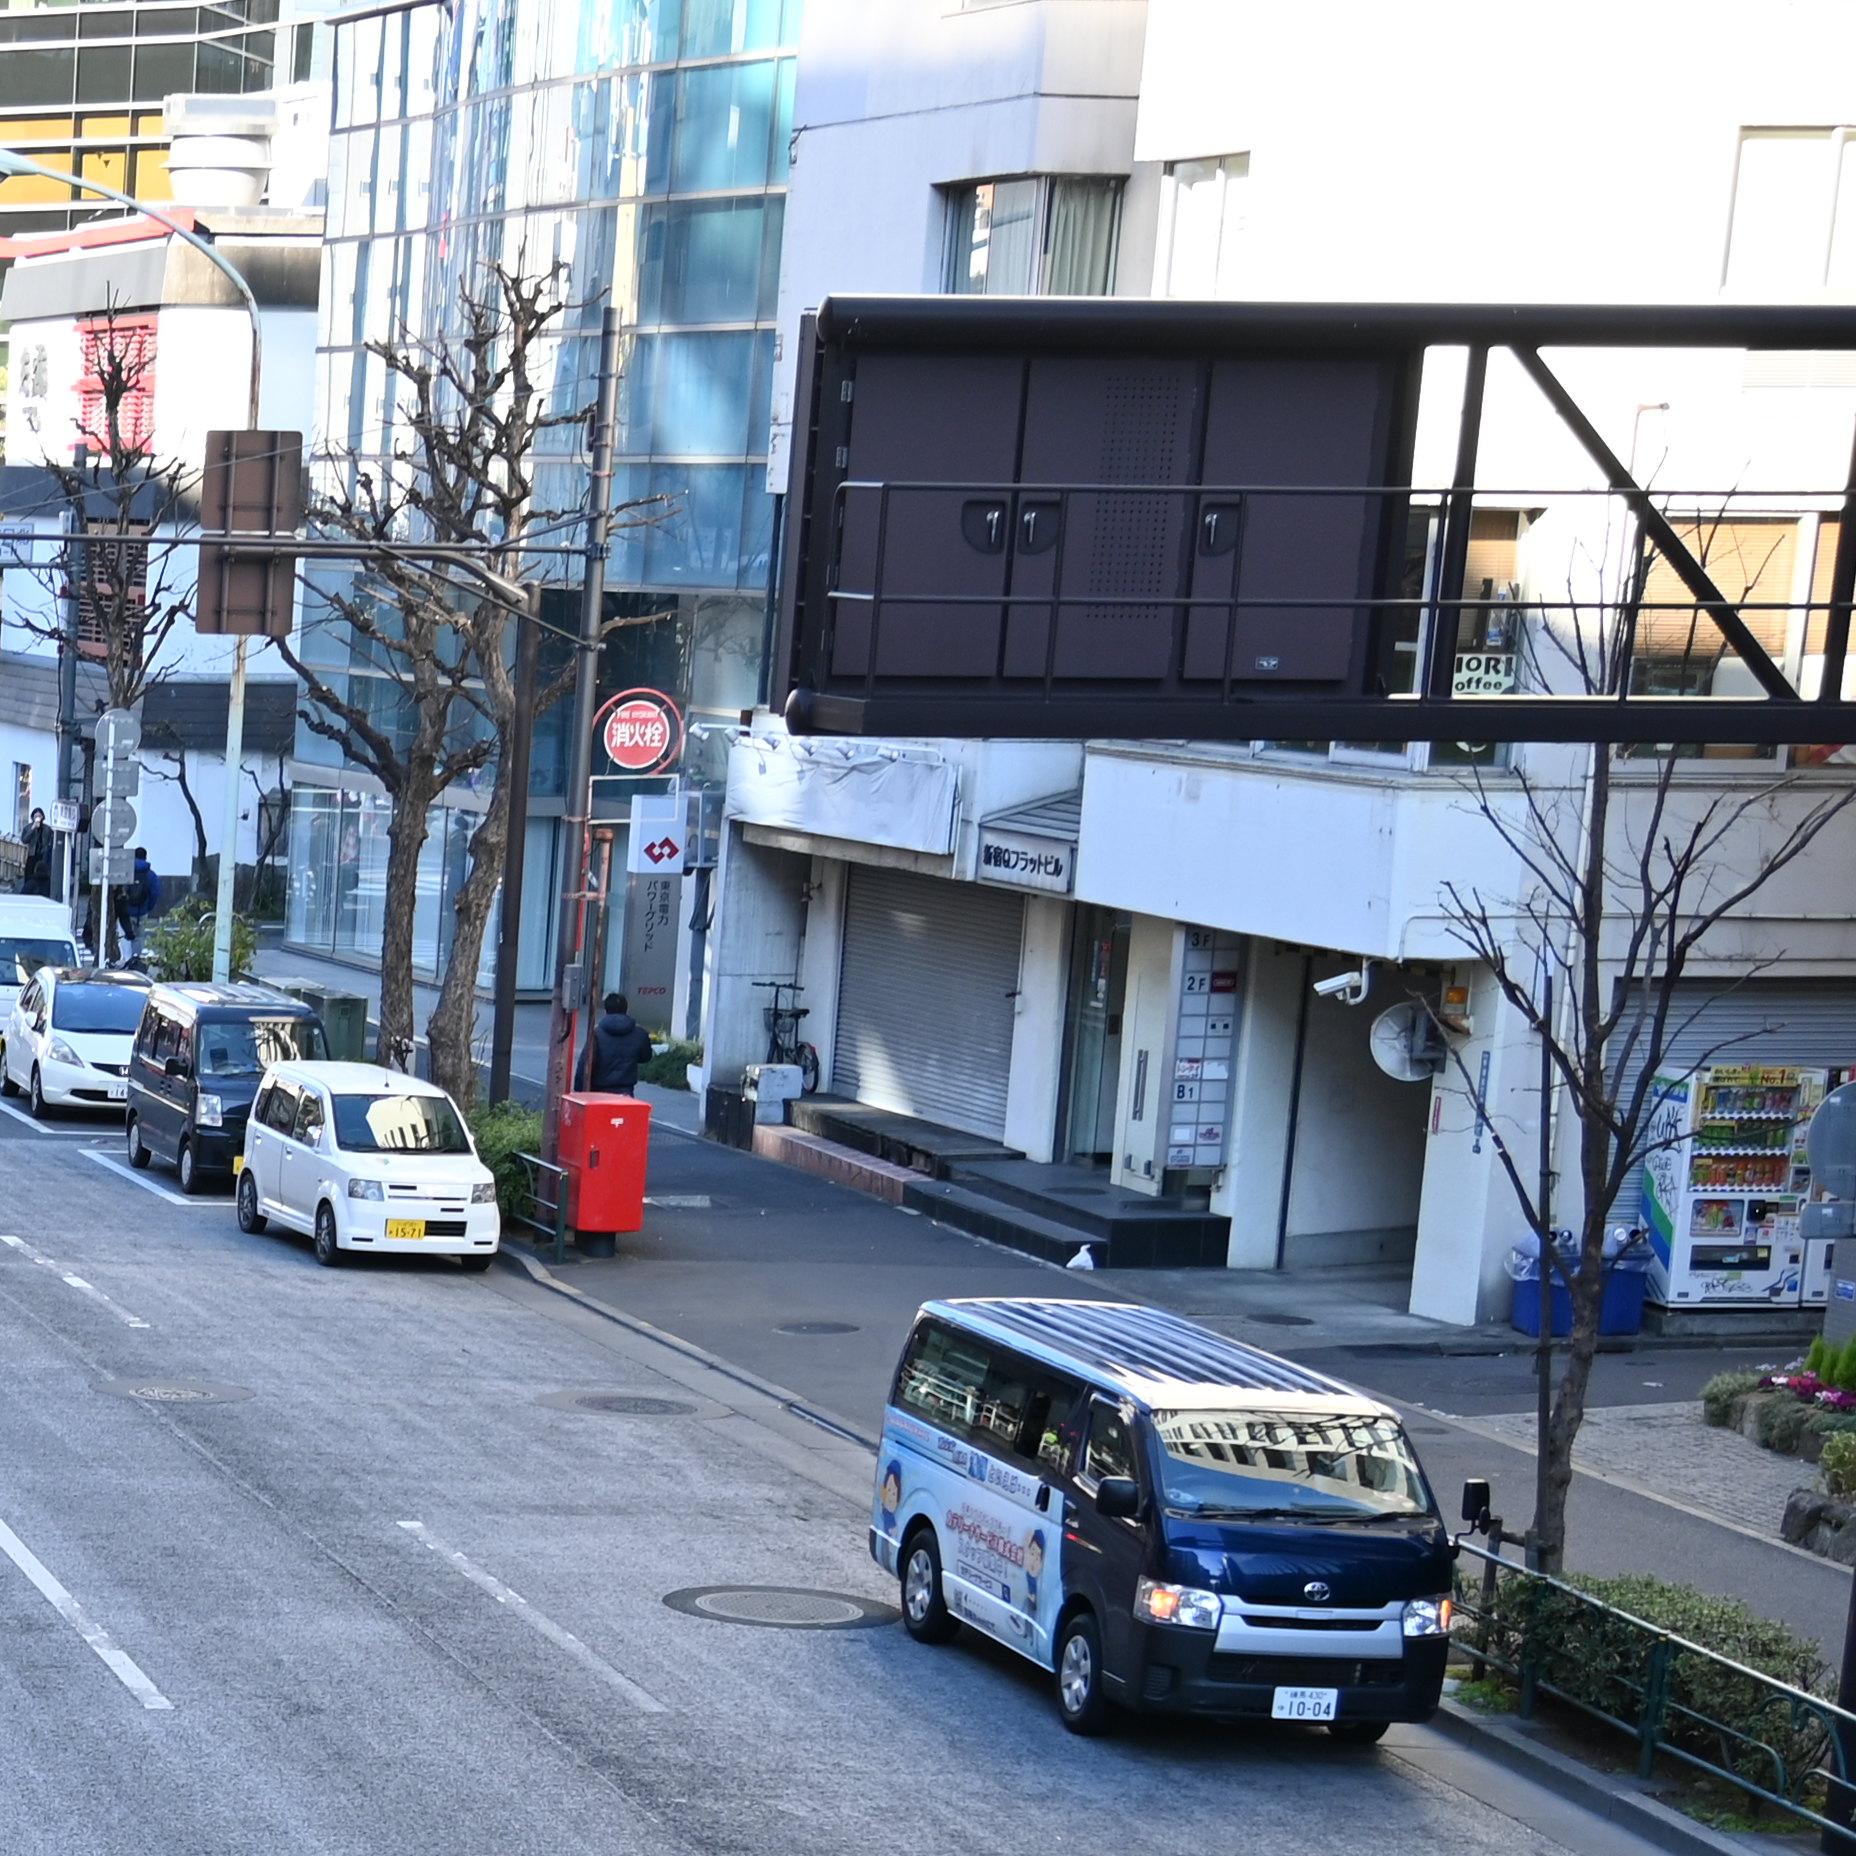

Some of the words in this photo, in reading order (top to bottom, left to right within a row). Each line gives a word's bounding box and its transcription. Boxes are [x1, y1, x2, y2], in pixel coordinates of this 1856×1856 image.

[1455, 676, 1503, 692] offee
[611, 722, 664, 748] 消火栓
[983, 844, 1063, 877] 新宿Qフラットビル
[659, 880, 671, 926] 東京電力
[644, 880, 658, 952] パワーグリッド
[638, 986, 666, 995] TEPCO
[1187, 976, 1207, 991] 2F
[1177, 1084, 1194, 1099] B1
[1288, 1701, 1331, 1717] 10-04
